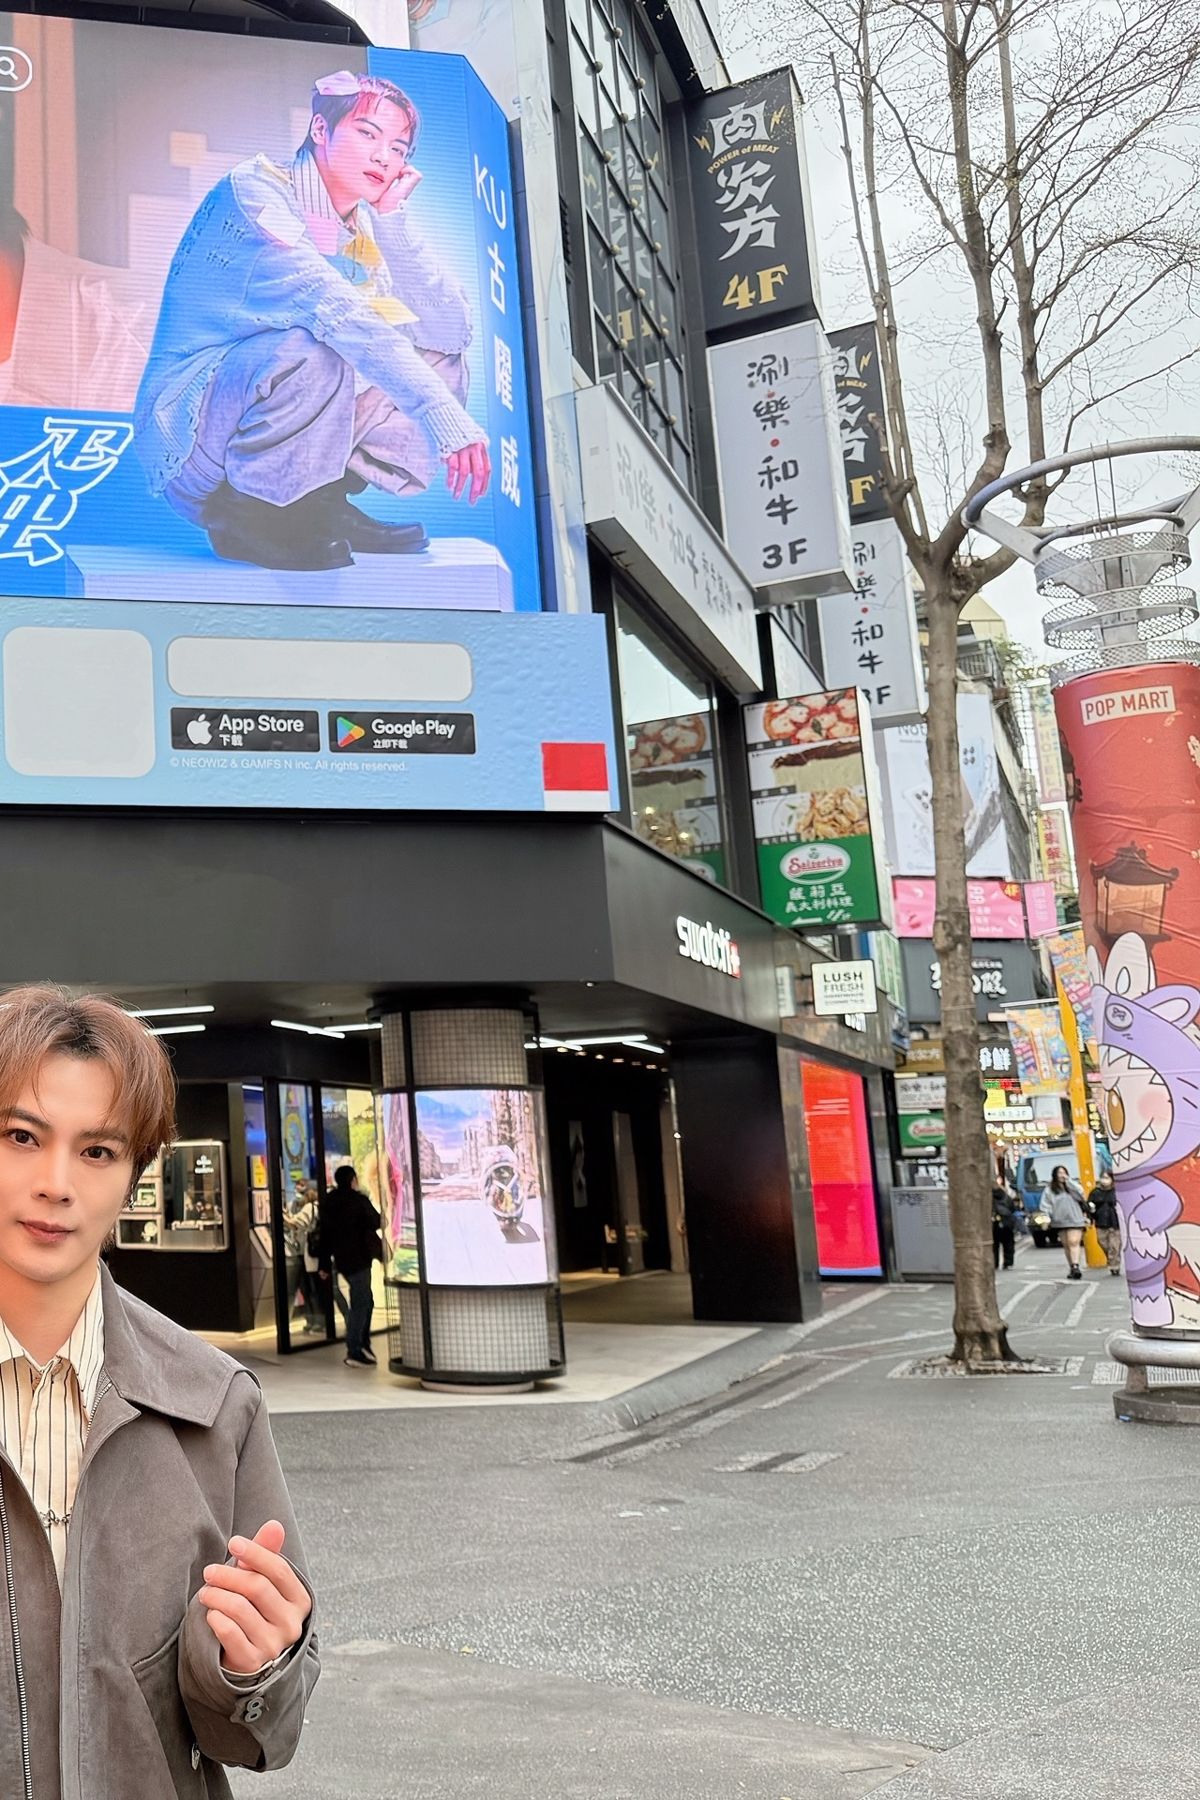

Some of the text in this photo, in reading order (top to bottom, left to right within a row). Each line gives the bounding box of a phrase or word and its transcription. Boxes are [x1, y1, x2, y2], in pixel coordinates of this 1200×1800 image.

[707, 150, 740, 174] POWER
[752, 144, 780, 154] MEAT
[722, 263, 789, 310] 4F
[761, 537, 808, 570] 3F
[1085, 690, 1170, 721] POP MART
[218, 714, 305, 734] App Store
[371, 718, 456, 738] Google Play
[182, 757, 227, 769] NEOWIZ
[315, 760, 328, 771] All
[329, 760, 362, 774] rights
[365, 761, 408, 773] reserved.
[823, 972, 863, 983] LUSH
